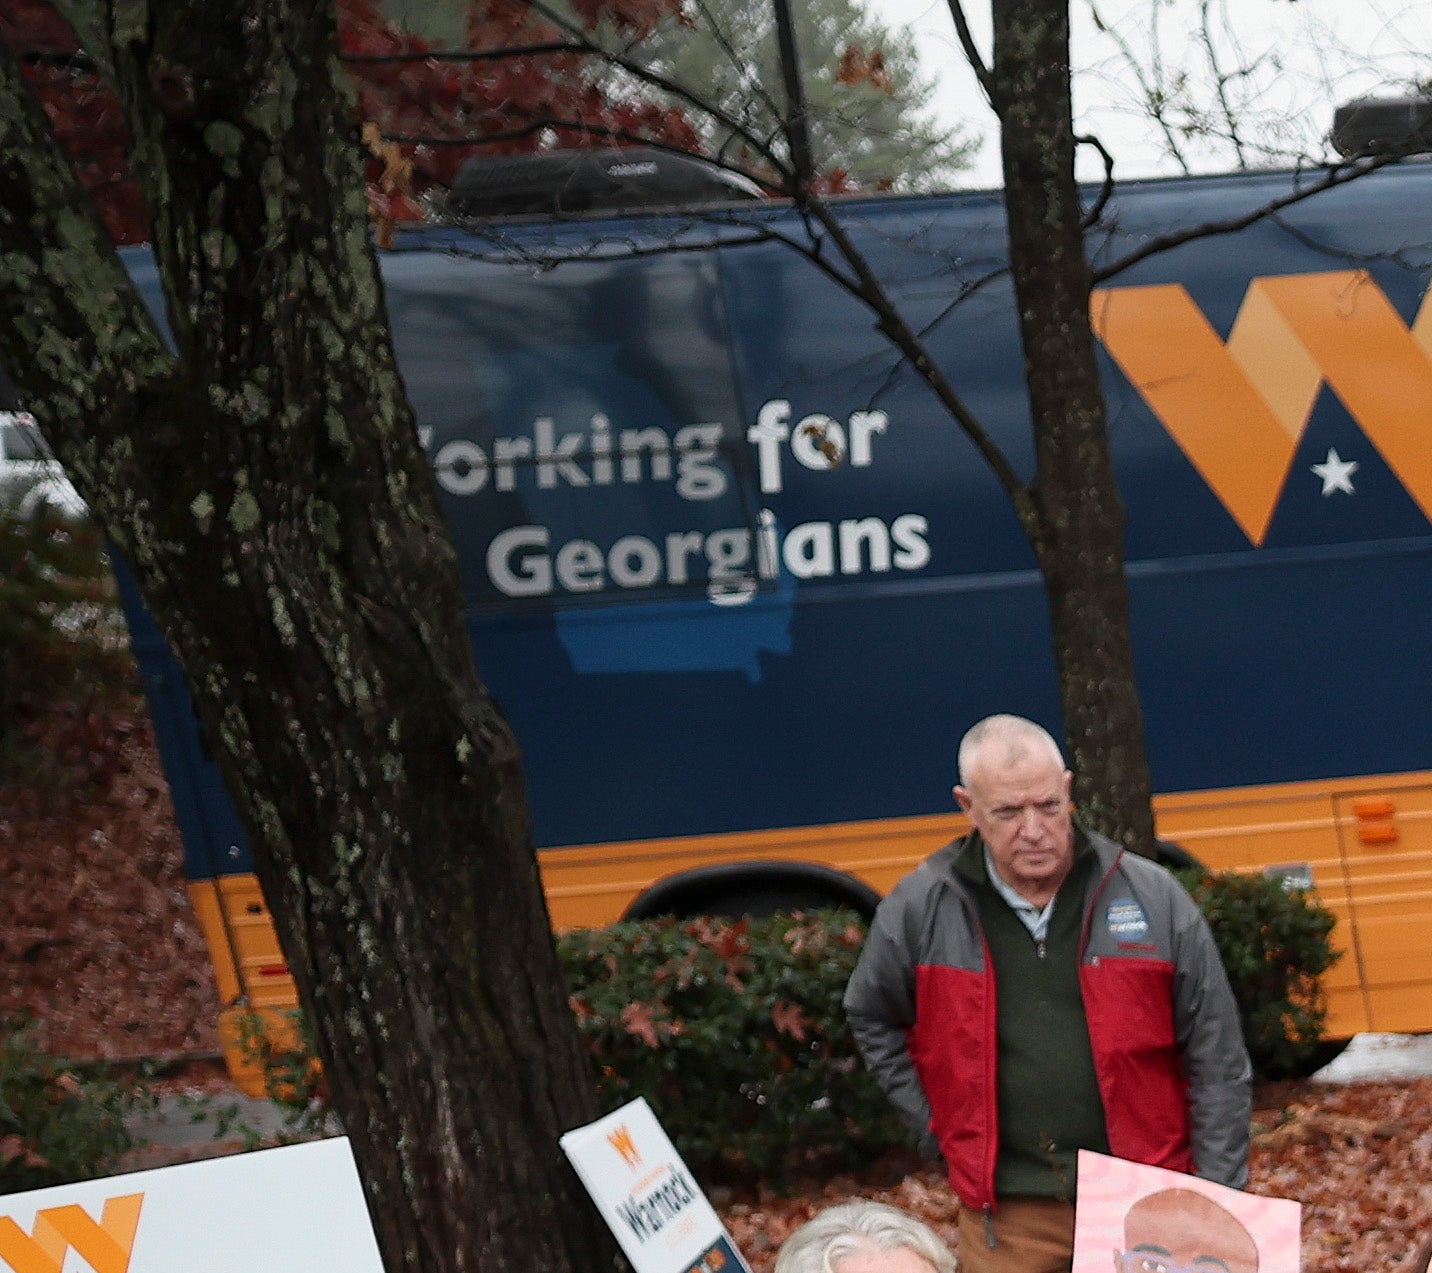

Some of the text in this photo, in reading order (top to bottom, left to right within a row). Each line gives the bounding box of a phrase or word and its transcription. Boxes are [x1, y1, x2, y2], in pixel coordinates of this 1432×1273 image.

[419, 399, 889, 500] orking for
[487, 508, 931, 606] Georgians
